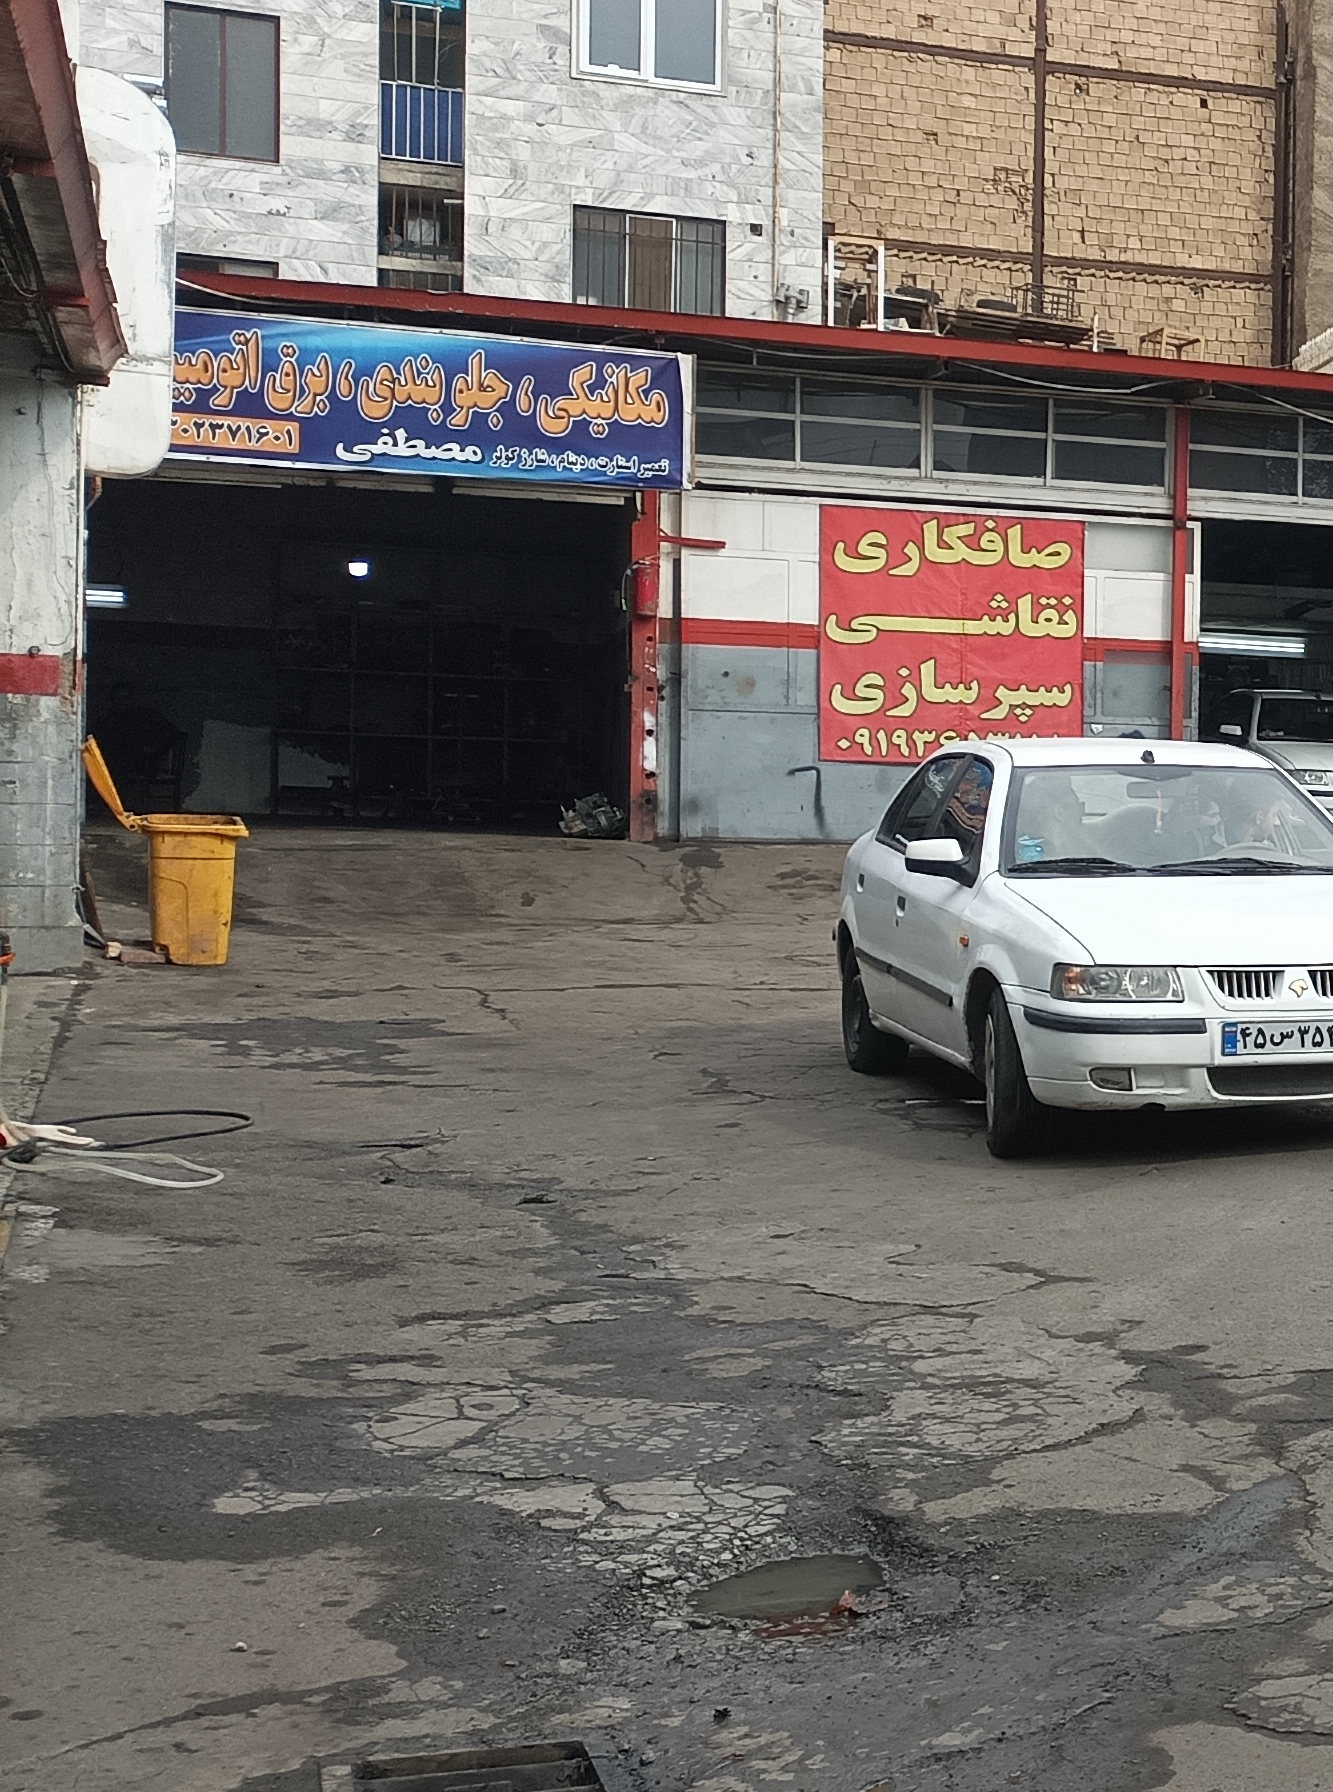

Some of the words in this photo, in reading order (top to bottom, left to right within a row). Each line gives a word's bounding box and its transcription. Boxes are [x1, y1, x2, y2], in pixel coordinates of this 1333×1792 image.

[265, 344, 331, 416] برق
[448, 350, 512, 429] جلو
[171, 417, 294, 449] ۰۲۳۷۱۶۰۱
[335, 428, 483, 463] مصطفی
[490, 445, 519, 468] کولر
[637, 459, 670, 477] تعمیر
[833, 518, 1072, 577] صافکاری
[825, 592, 1077, 645] نقاشی
[830, 657, 979, 717] سازی
[979, 682, 1072, 723] سپر
